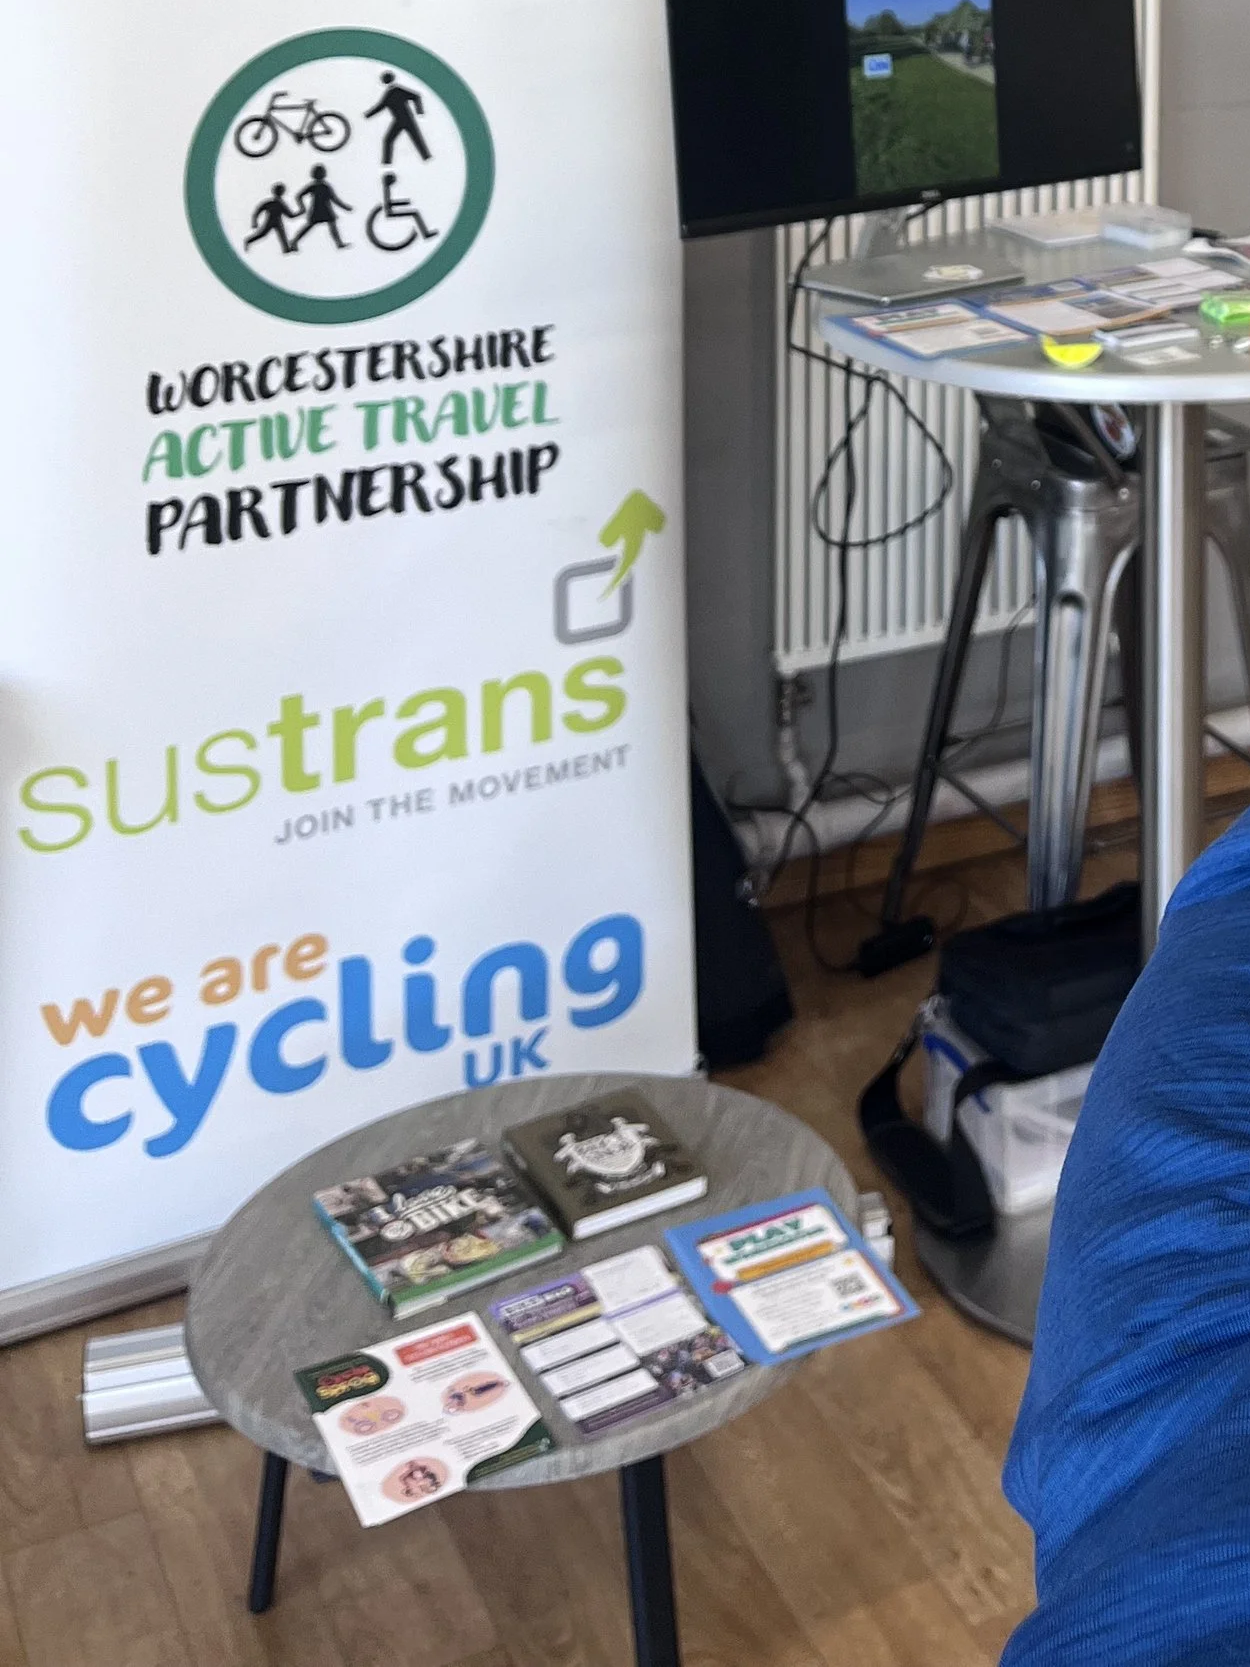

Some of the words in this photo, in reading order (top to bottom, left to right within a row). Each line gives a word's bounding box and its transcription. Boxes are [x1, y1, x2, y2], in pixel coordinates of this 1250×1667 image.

[146, 324, 555, 417] WORCESTERSHIRE
[142, 404, 337, 483] ACTIVE
[354, 380, 558, 452] TRAVEL
[146, 442, 561, 556] PARTNERSHIP
[17, 655, 628, 854] sustrans
[274, 805, 355, 846] JOIN
[366, 786, 436, 824] THE
[448, 742, 631, 807] MOVEMENT
[40, 974, 173, 1047] we
[199, 933, 329, 1007] are
[45, 912, 646, 1159] cycling
[463, 1026, 550, 1089] UK
[729, 1218, 804, 1251] PLAY
